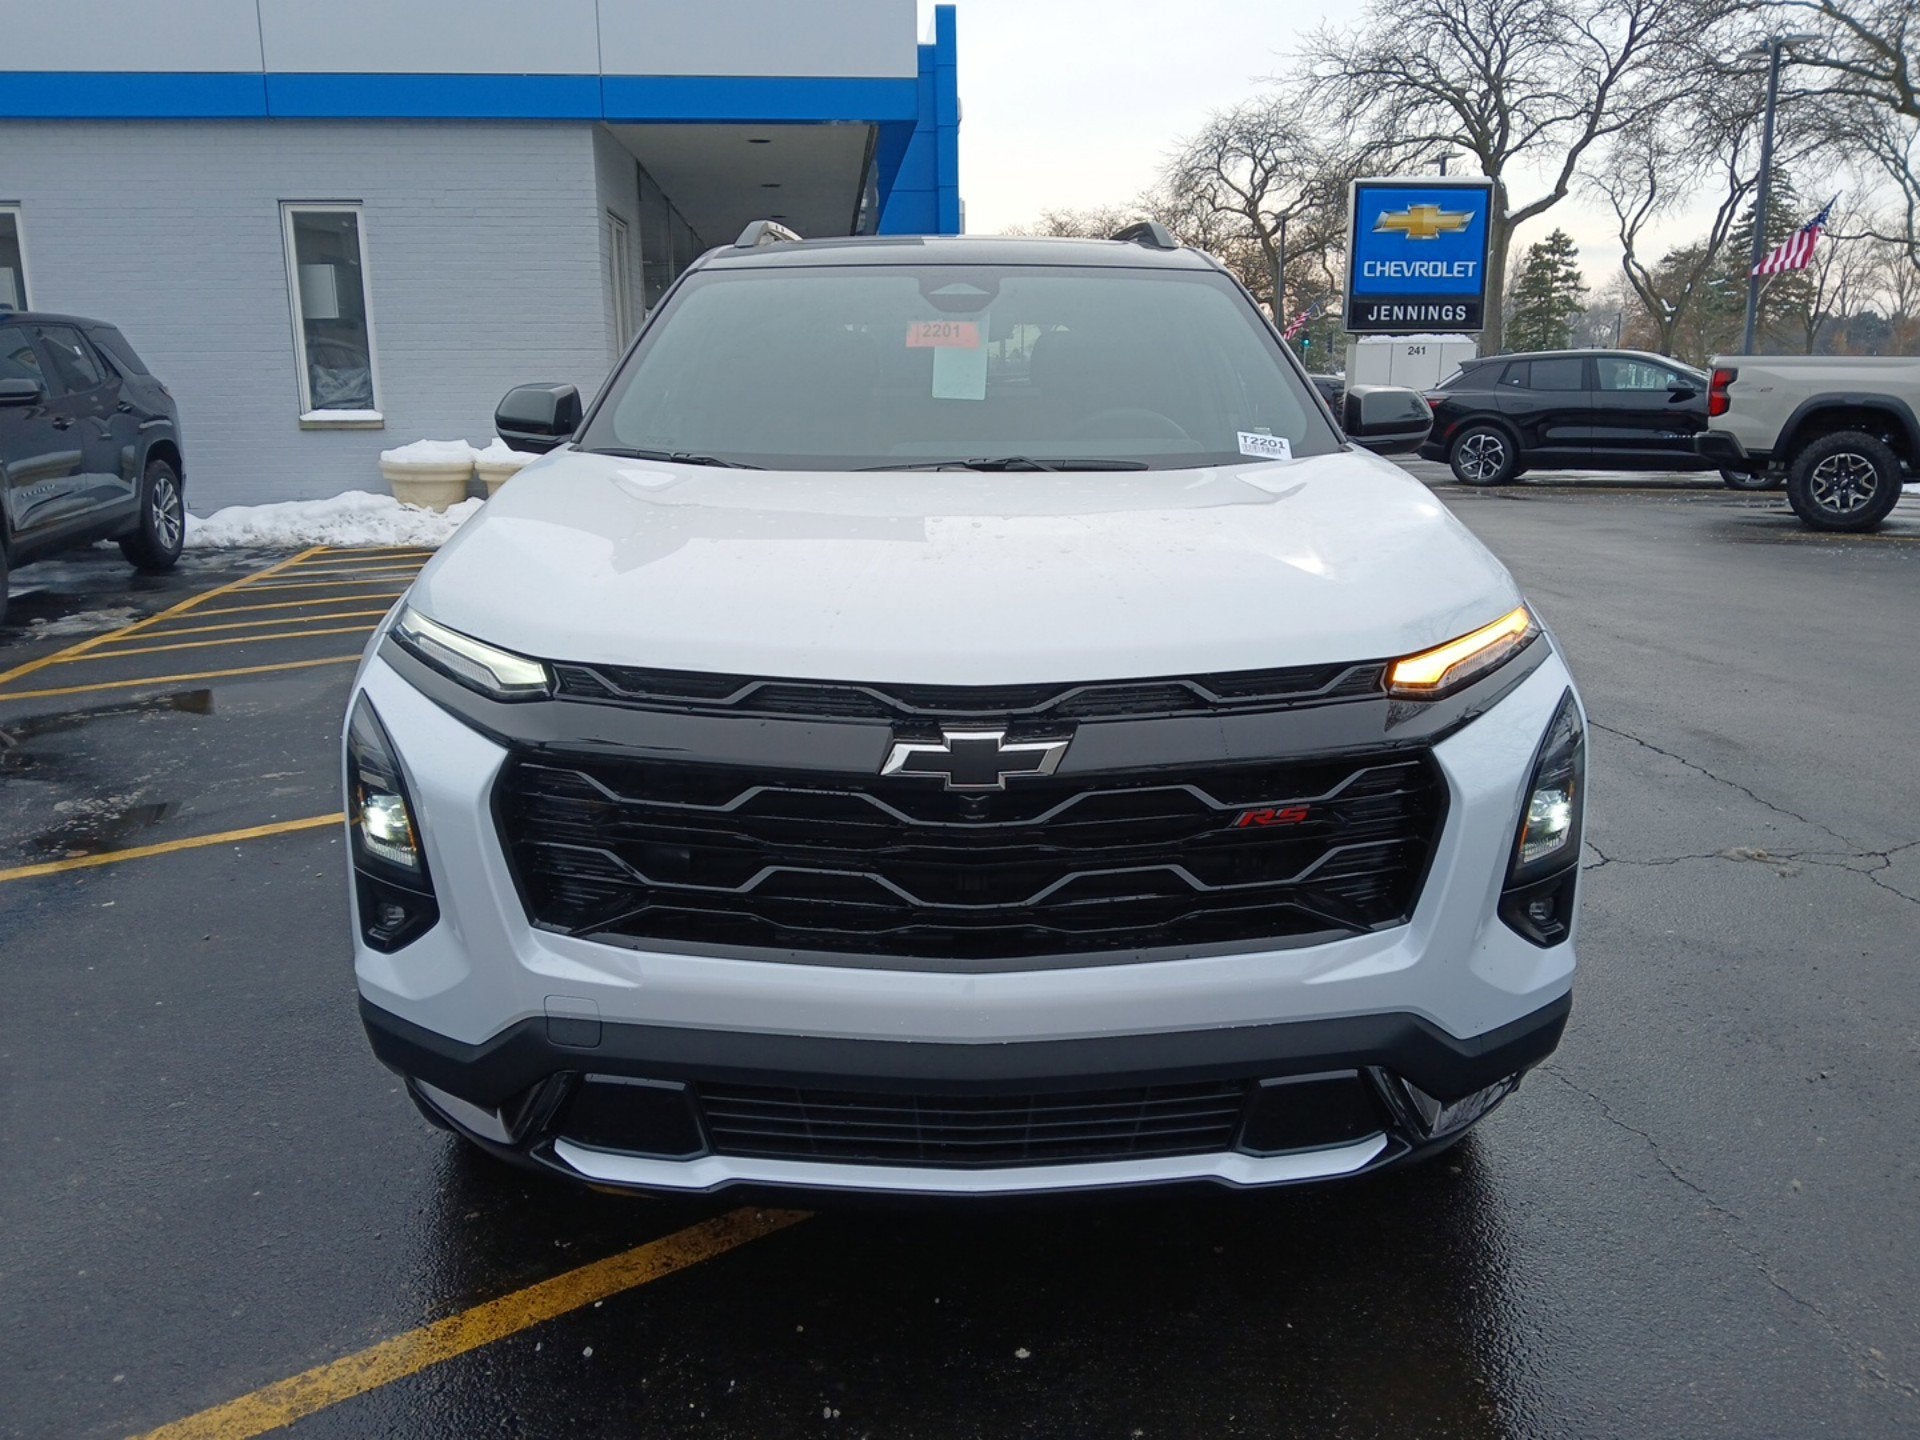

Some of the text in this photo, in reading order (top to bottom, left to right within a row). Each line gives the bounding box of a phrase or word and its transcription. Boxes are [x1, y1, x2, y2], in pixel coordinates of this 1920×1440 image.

[1363, 261, 1477, 277] CHEVROLET
[1368, 306, 1466, 321] JENNINGS
[922, 324, 960, 338] 2201
[1407, 346, 1426, 355] 241
[1241, 435, 1286, 449] T2201
[1235, 805, 1309, 828] RS
